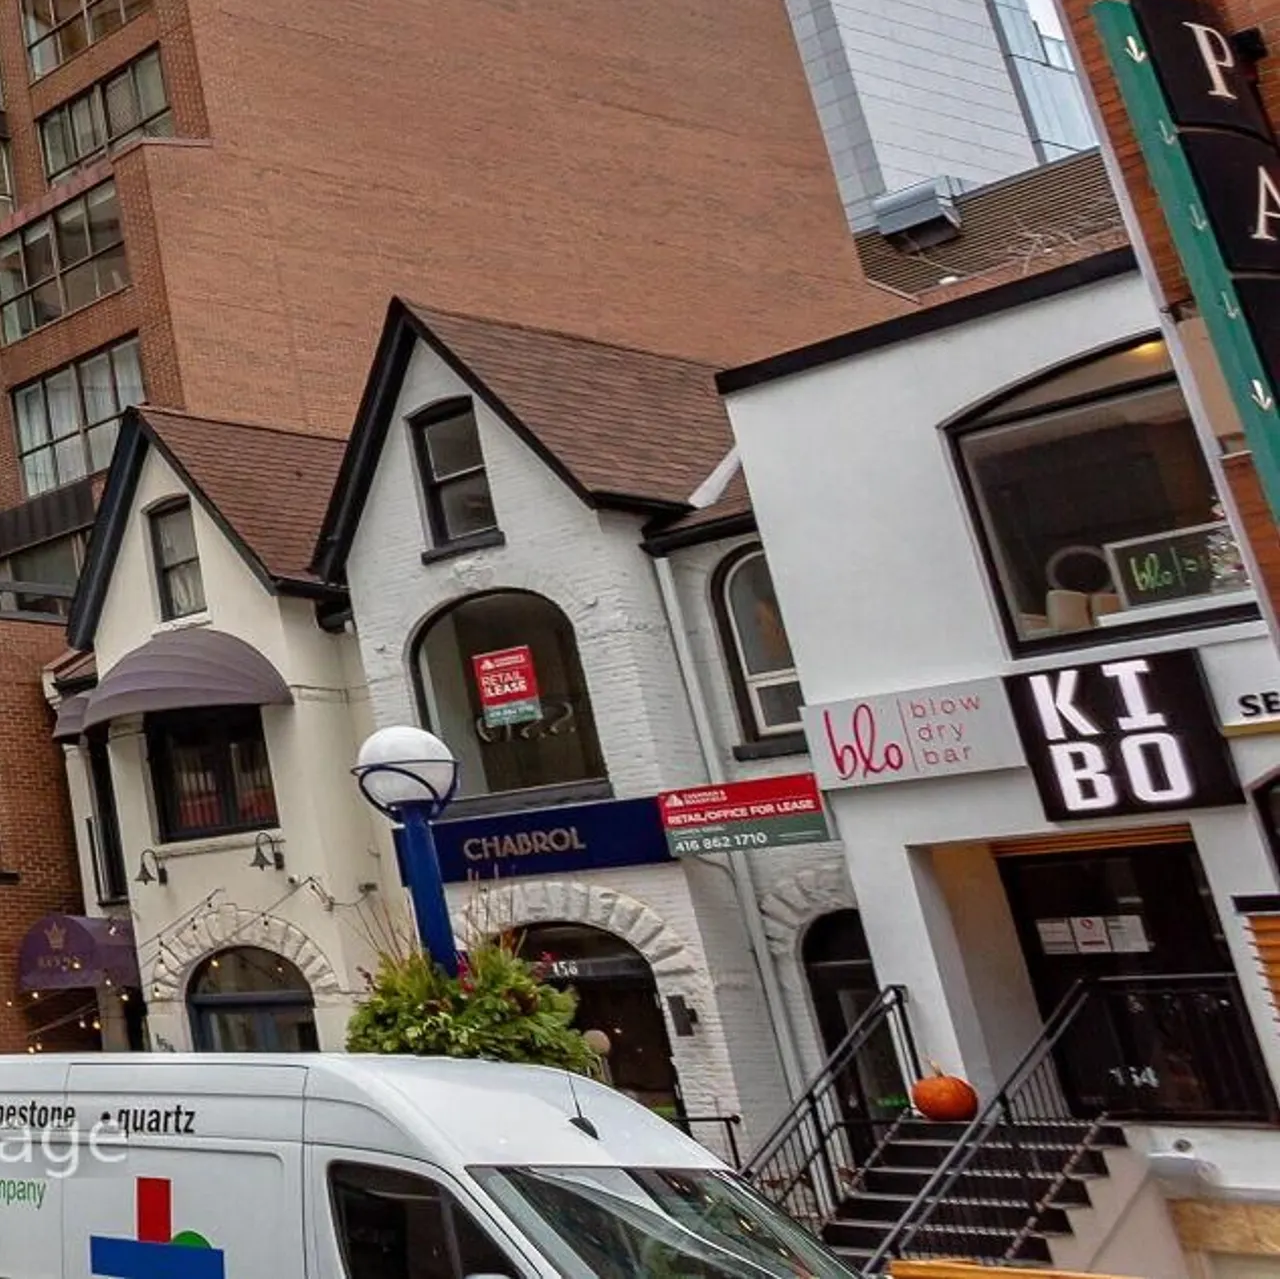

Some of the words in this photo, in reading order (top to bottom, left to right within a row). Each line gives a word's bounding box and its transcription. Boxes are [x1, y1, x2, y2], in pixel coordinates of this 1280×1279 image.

[481, 671, 525, 686] RETAIL
[487, 680, 527, 697] LEASE
[909, 694, 982, 718] blow
[823, 703, 903, 781] blo
[918, 721, 965, 744] dry
[924, 746, 972, 765] bar
[668, 806, 747, 825] RETAIL/OFFICE
[750, 804, 774, 815] FOR
[777, 799, 815, 812] LEASE
[463, 826, 587, 861] CHABROL
[734, 831, 768, 846] 1710
[117, 1105, 196, 1138] quartz
